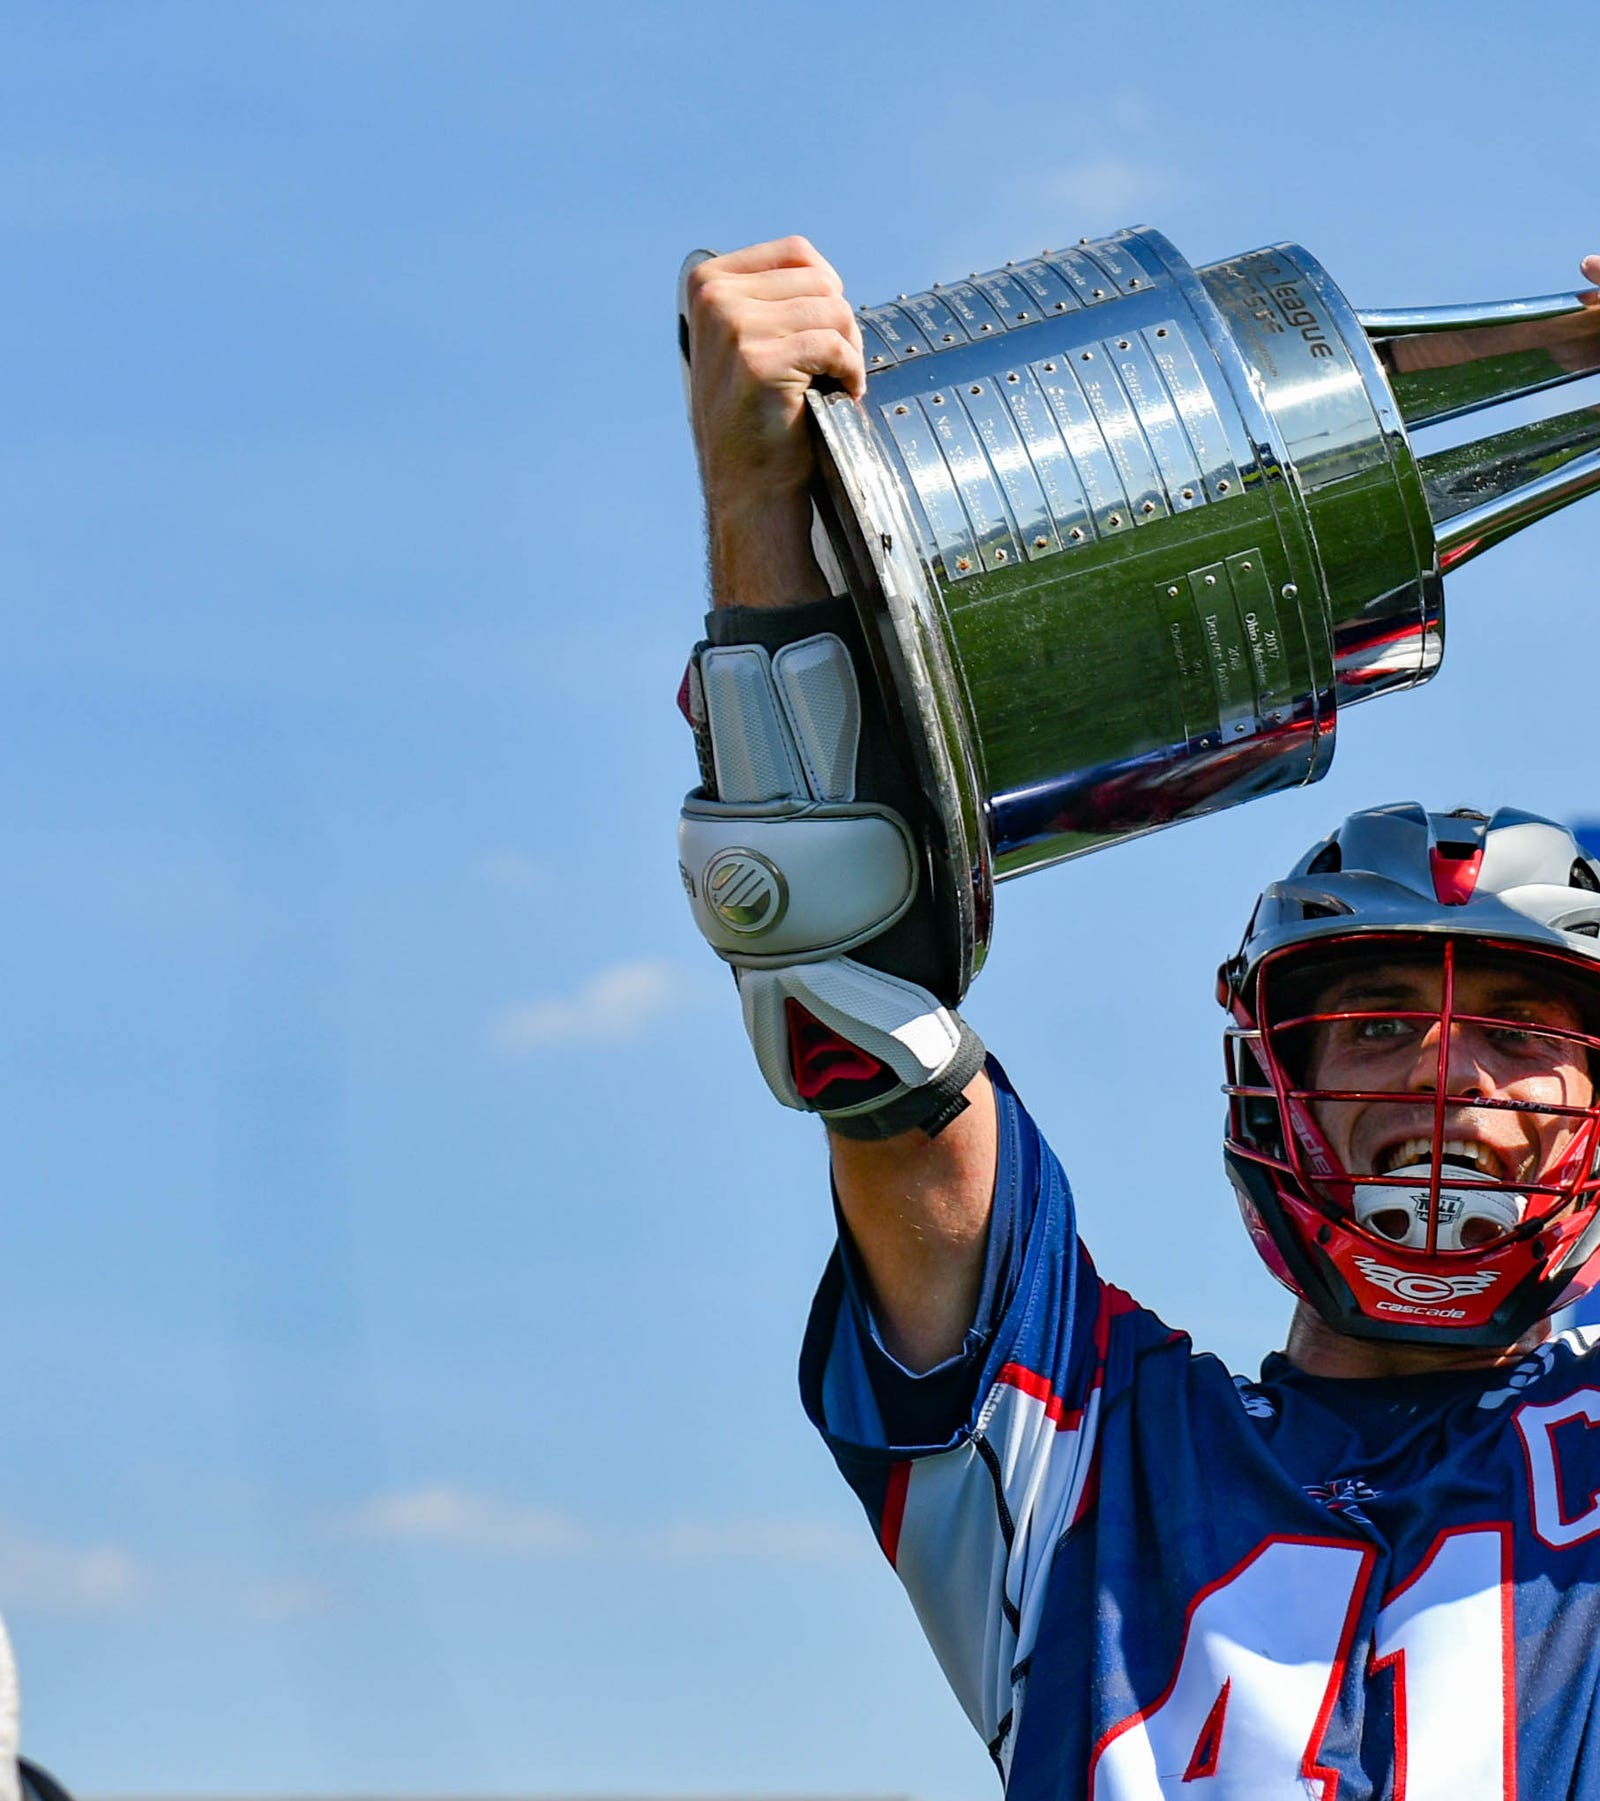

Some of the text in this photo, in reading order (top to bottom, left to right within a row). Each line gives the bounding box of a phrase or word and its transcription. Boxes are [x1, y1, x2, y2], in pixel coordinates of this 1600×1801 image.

[1245, 611, 1258, 642] Ohio
[1264, 630, 1280, 659] 2017
[1375, 1301, 1467, 1319] cascade
[1087, 1520, 1517, 1801] 41
